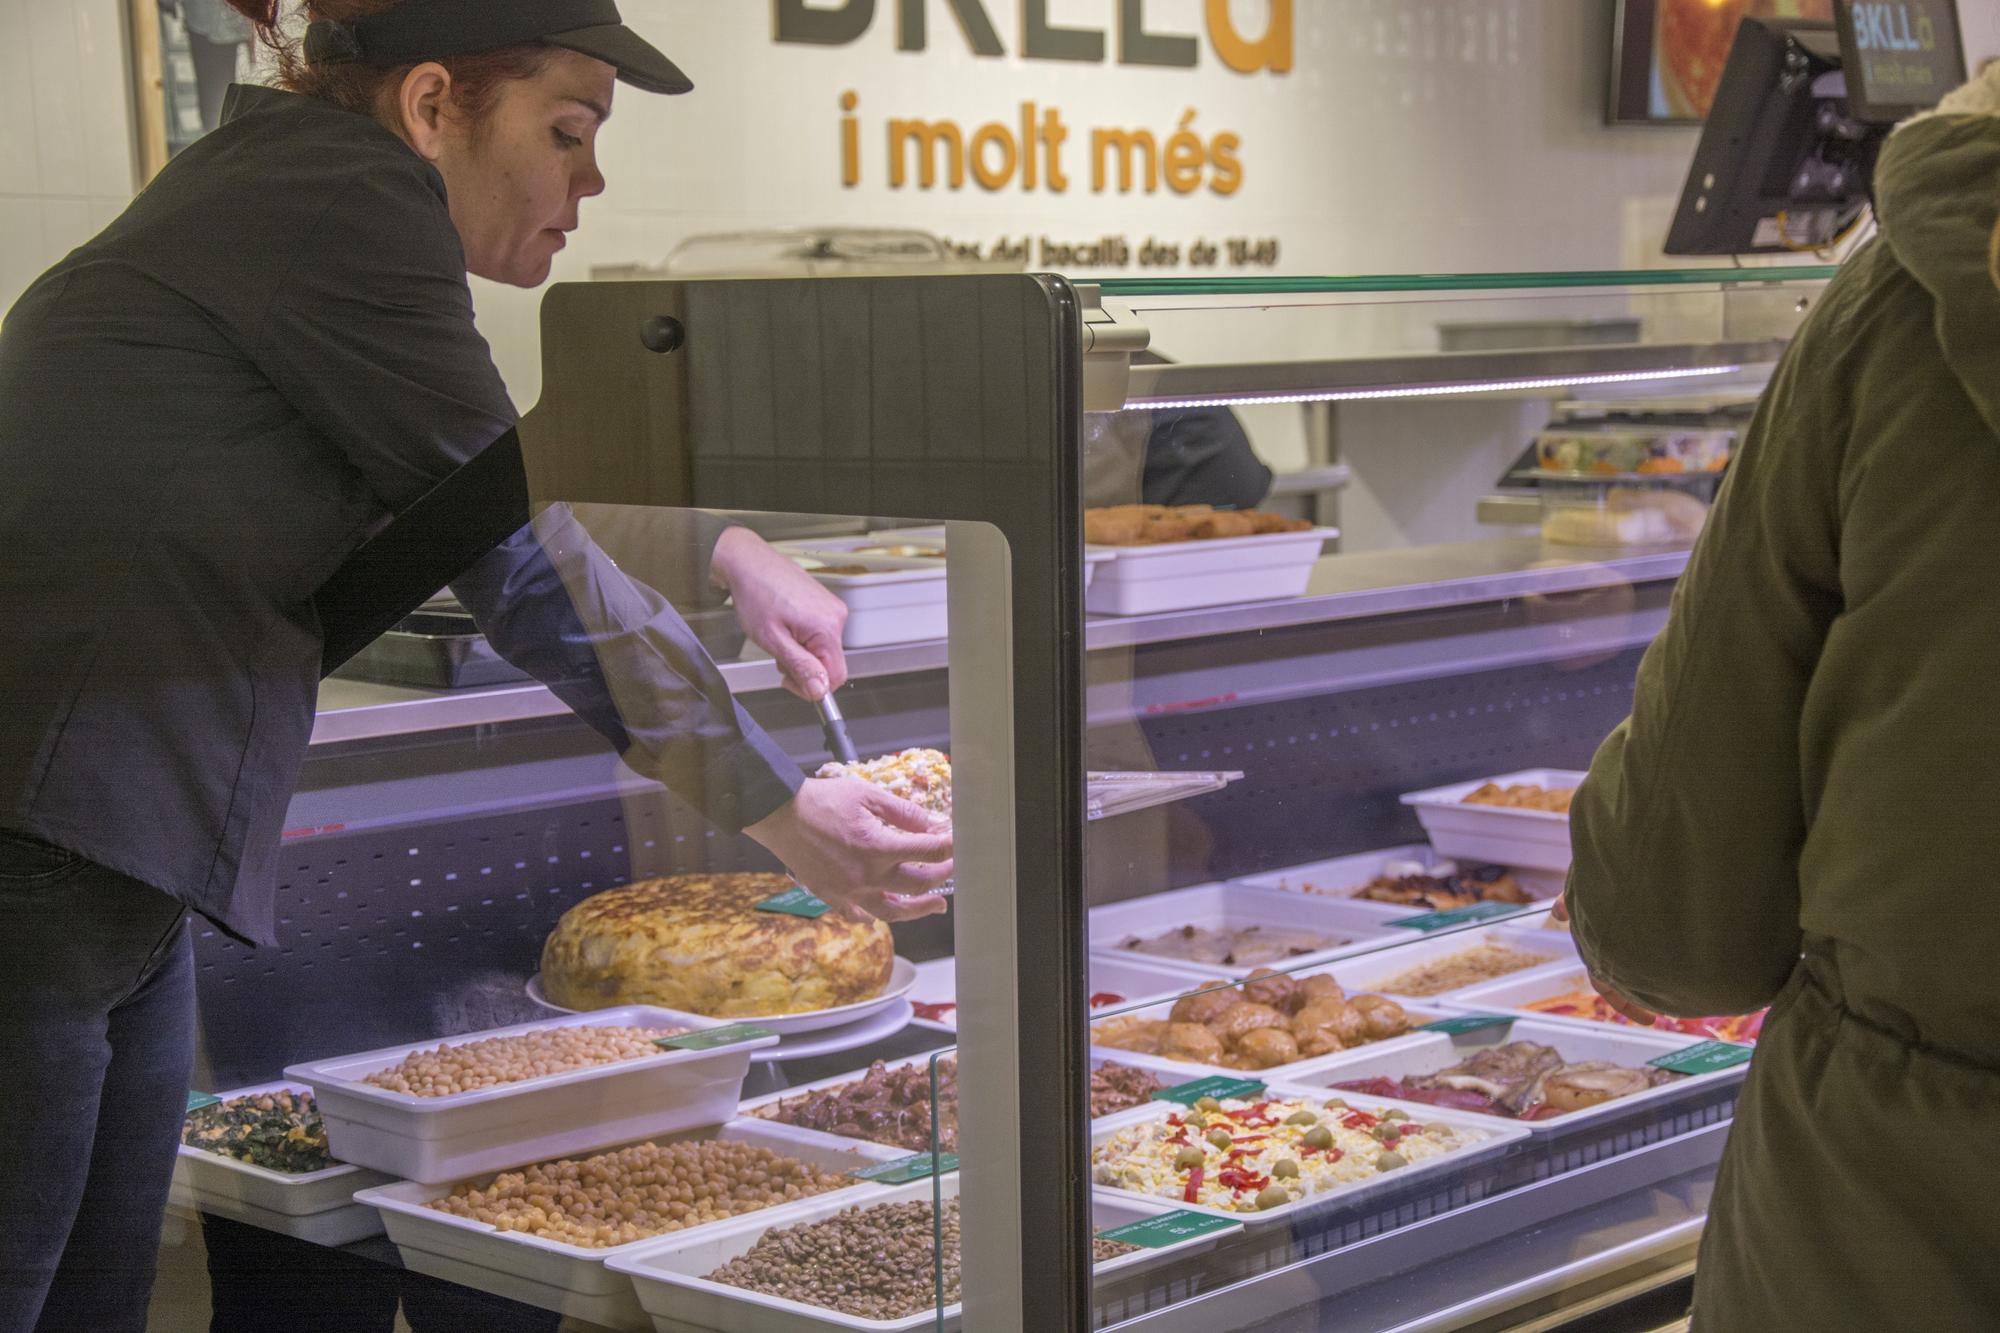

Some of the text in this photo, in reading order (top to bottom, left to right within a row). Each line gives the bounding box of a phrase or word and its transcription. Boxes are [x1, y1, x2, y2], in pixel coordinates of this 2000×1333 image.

[839, 89, 1244, 196] i molt més
[1137, 235, 1180, 267] des
[1187, 235, 1218, 267] de
